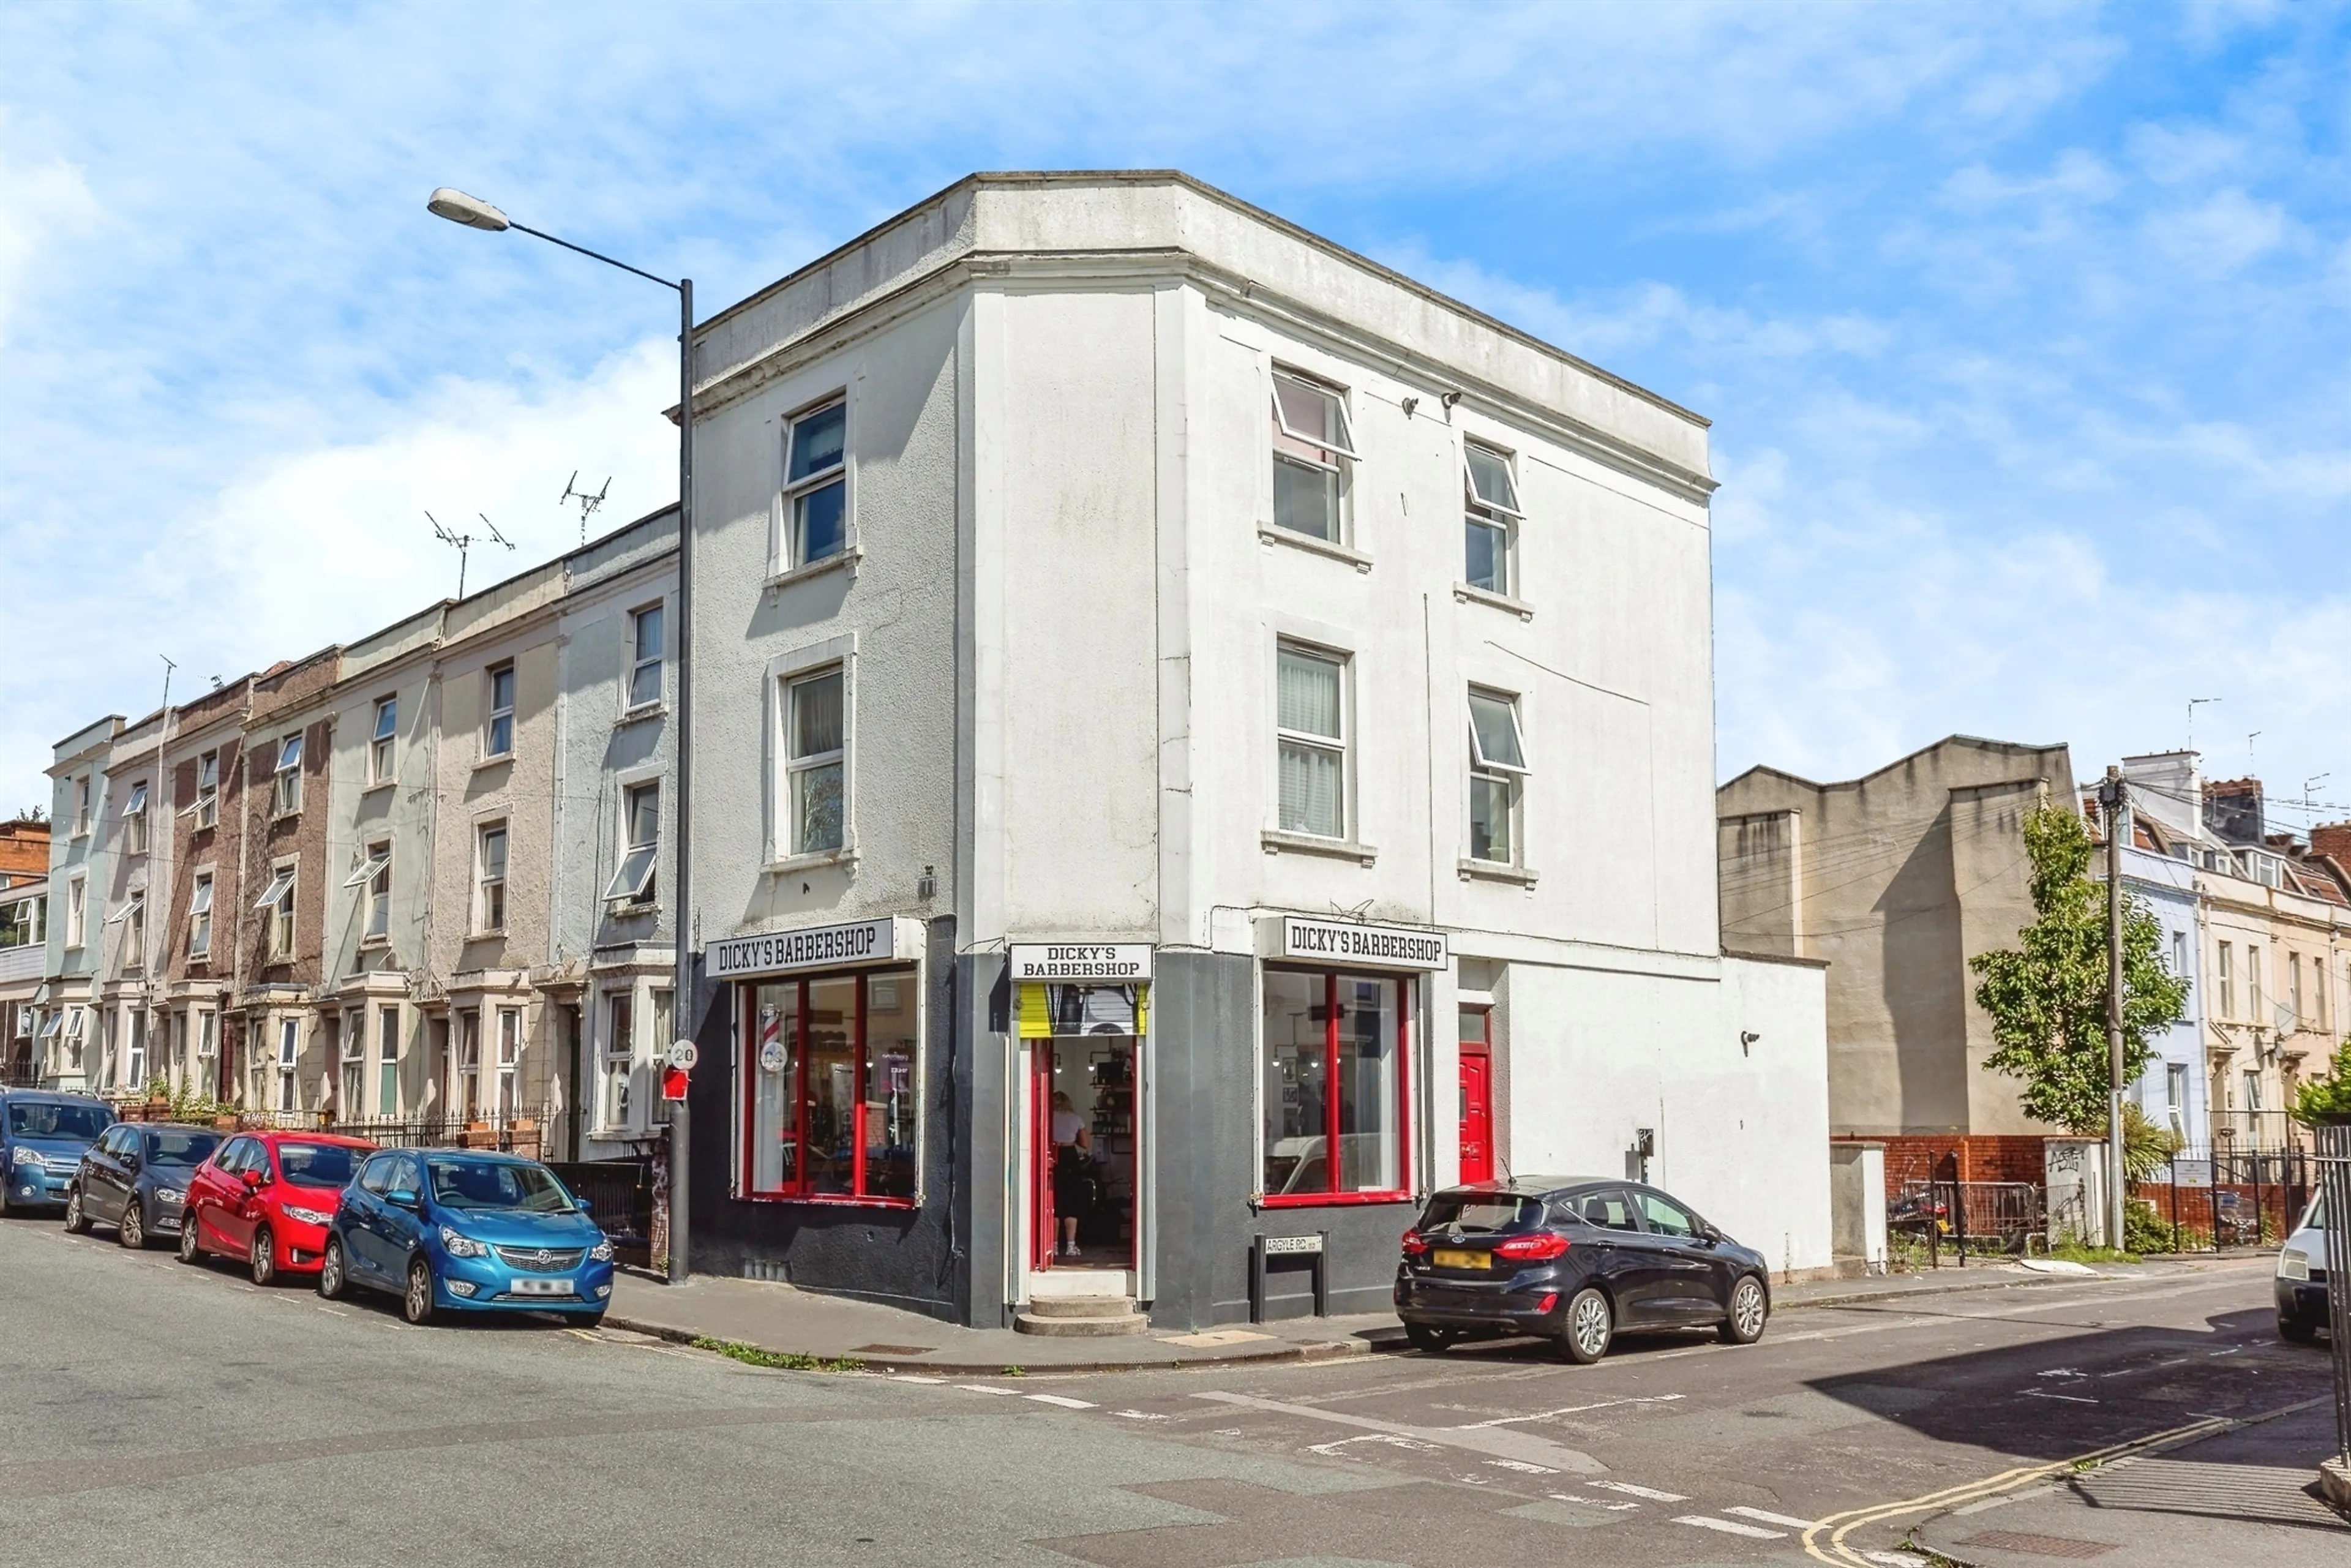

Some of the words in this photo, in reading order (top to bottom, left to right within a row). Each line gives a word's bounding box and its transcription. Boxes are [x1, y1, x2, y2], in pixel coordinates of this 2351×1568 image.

[719, 940, 772, 970] DICKY'S
[775, 926, 876, 964] BARBERSHOP
[1292, 926, 1349, 953] DICKY'S
[1352, 932, 1441, 962] BARBERSHOP
[1048, 947, 1116, 960] DICKY'S
[1024, 962, 1139, 975] BARBERSHOP
[675, 1049, 693, 1062] 20
[1267, 1239, 1294, 1251] ARGYLE
